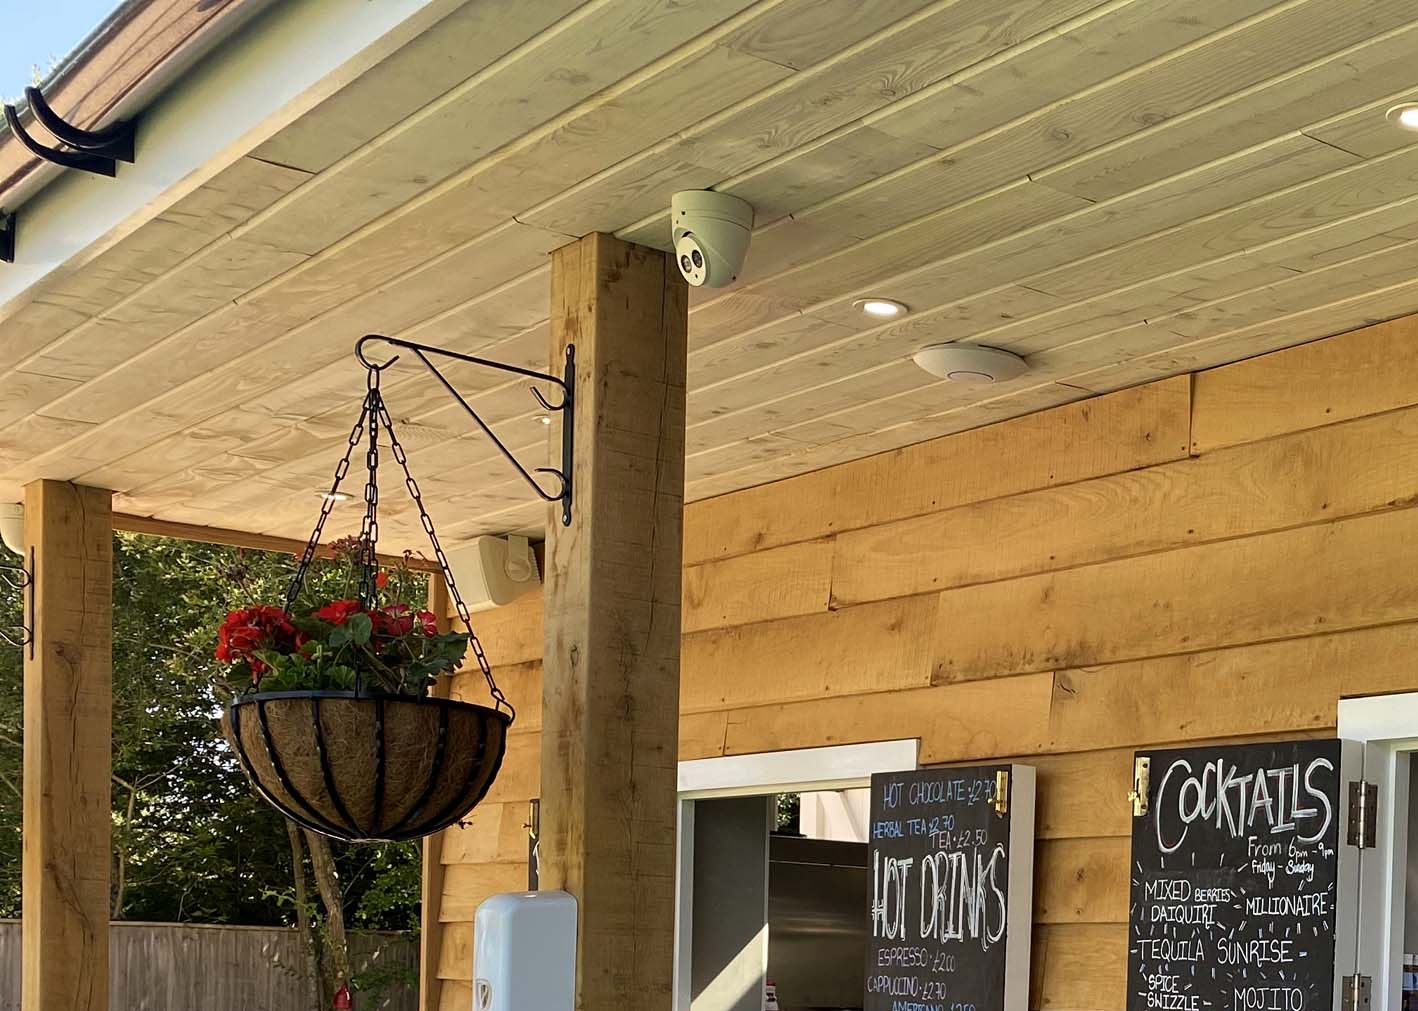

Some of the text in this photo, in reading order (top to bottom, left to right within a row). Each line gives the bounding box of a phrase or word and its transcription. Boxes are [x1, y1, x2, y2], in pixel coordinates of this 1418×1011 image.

[883, 783, 904, 810] HOT
[909, 780, 965, 805] CHOCOLATE
[1156, 757, 1334, 853] COCKTAILS
[873, 821, 904, 839] HERBAL
[907, 819, 926, 835] TEA
[929, 831, 952, 849] TEA
[1248, 836, 1282, 857] From
[1288, 836, 1308, 863] 6pm
[1318, 842, 1334, 859] 9pm
[872, 843, 1006, 951] HOT DRINKS
[1144, 879, 1231, 902] MIXED BERRIES
[1151, 904, 1218, 930] DAIQUIRI
[1246, 892, 1328, 917] MILLIONAIRE
[878, 947, 928, 967] ESPRESSO
[1137, 937, 1293, 967] TEQUILA SUNRISE
[1148, 974, 1180, 994] SPICE
